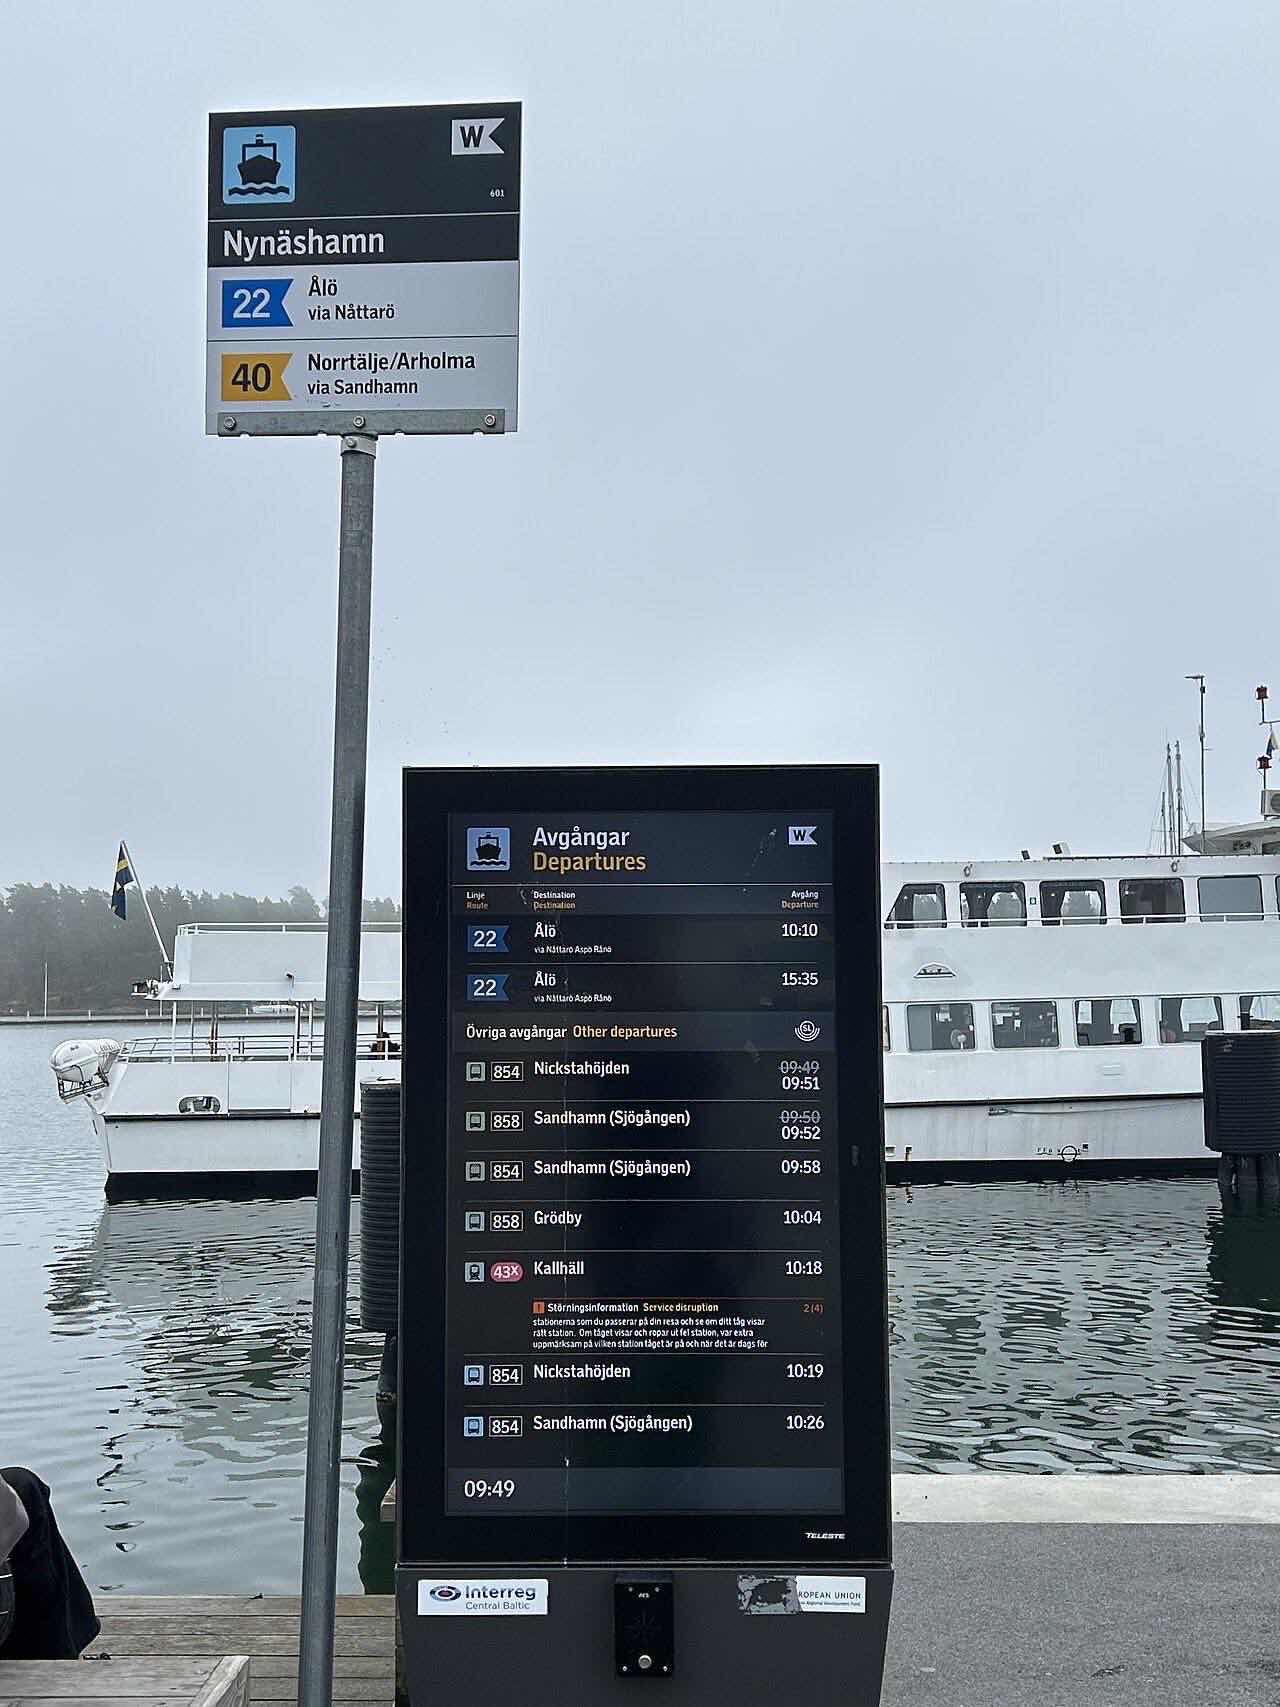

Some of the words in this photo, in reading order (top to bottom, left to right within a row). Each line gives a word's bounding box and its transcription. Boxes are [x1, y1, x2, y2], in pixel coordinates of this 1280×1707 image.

[459, 125, 484, 148] W
[489, 189, 504, 198] 601
[223, 228, 385, 262] Nynäshamn
[308, 275, 338, 297] Ålö
[232, 288, 271, 319] 22
[307, 305, 331, 321] via
[335, 303, 395, 320] Nåttarö
[307, 352, 476, 374] Norrtälje/Arholma
[231, 362, 272, 393] 40
[307, 380, 331, 396] via
[334, 378, 418, 395] Sandhamn
[532, 825, 631, 850] Avgångar
[791, 829, 807, 842] W
[532, 852, 647, 875] Departures
[466, 891, 486, 901] Linje
[533, 890, 576, 899] Destination
[791, 889, 819, 900] Avgång
[466, 901, 489, 910] Route
[533, 901, 576, 910] Destination
[781, 900, 819, 910] Departure
[534, 921, 557, 938] Ålö
[781, 923, 818, 937] 10:10
[473, 930, 497, 948] 22
[534, 946, 545, 954] via
[534, 970, 557, 987] Ålö
[781, 972, 819, 986] 15:35
[473, 979, 497, 997] 22
[534, 995, 545, 1003] via
[466, 1023, 507, 1041] Övriga
[509, 1024, 568, 1041] avgångar
[572, 1025, 608, 1039] Other
[610, 1024, 678, 1041] departures
[493, 1065, 520, 1079] 854
[534, 1060, 630, 1077] Nickstahöjden
[779, 1060, 820, 1074] 09:49
[781, 1077, 821, 1091] 09:51
[493, 1115, 520, 1129] 858
[533, 1110, 606, 1125] Sandhamn
[609, 1109, 691, 1127] (Sjögången)
[780, 1110, 821, 1124] 09:50
[781, 1126, 821, 1140] 09:52
[493, 1164, 520, 1179] 854
[533, 1160, 606, 1175] Sandhamn
[609, 1159, 691, 1177] (Sjögången)
[781, 1160, 821, 1175] 09:58
[493, 1215, 520, 1229] 858
[534, 1210, 582, 1228] Grödby
[783, 1210, 822, 1224] 10:04
[534, 1260, 584, 1275] Kallhäll
[785, 1260, 823, 1275] 10:18
[547, 1302, 639, 1314] Störningsinformation
[643, 1302, 674, 1312] Service
[675, 1302, 719, 1313] disruption
[576, 1317, 593, 1327] som
[593, 1317, 604, 1327] du
[605, 1317, 637, 1327] passerar
[638, 1317, 649, 1327] på
[649, 1317, 661, 1327] din
[663, 1317, 680, 1327] resa
[680, 1317, 694, 1327] och
[695, 1317, 704, 1327] se
[705, 1317, 718, 1327] om
[718, 1317, 732, 1327] ditt
[733, 1317, 746, 1327] tåg
[746, 1317, 765, 1327] visar
[579, 1328, 593, 1338] Om
[614, 1328, 632, 1338] visar
[634, 1328, 647, 1338] och
[648, 1328, 669, 1338] ropar
[670, 1328, 679, 1338] ut
[680, 1328, 690, 1338] fel
[734, 1328, 754, 1338] extra
[583, 1339, 593, 1349] på
[594, 1339, 617, 1349] vilken
[617, 1339, 643, 1349] station
[674, 1339, 685, 1349] på
[686, 1339, 700, 1349] och
[714, 1339, 727, 1349] det
[737, 1339, 756, 1349] dags
[492, 1368, 519, 1383] 854
[533, 1363, 631, 1380] Nickstahöjden
[786, 1363, 824, 1378] 10:19
[492, 1419, 519, 1434] 854
[533, 1415, 607, 1430] Sandhamn
[610, 1415, 693, 1433] (Sjögången)
[786, 1415, 825, 1430] 10:26
[464, 1479, 516, 1498] 09:49
[804, 1532, 846, 1540] TELESTE
[465, 1585, 537, 1601] Interreg
[834, 1591, 862, 1600] UNION
[465, 1601, 501, 1610] Central
[503, 1601, 531, 1610] Baltic
